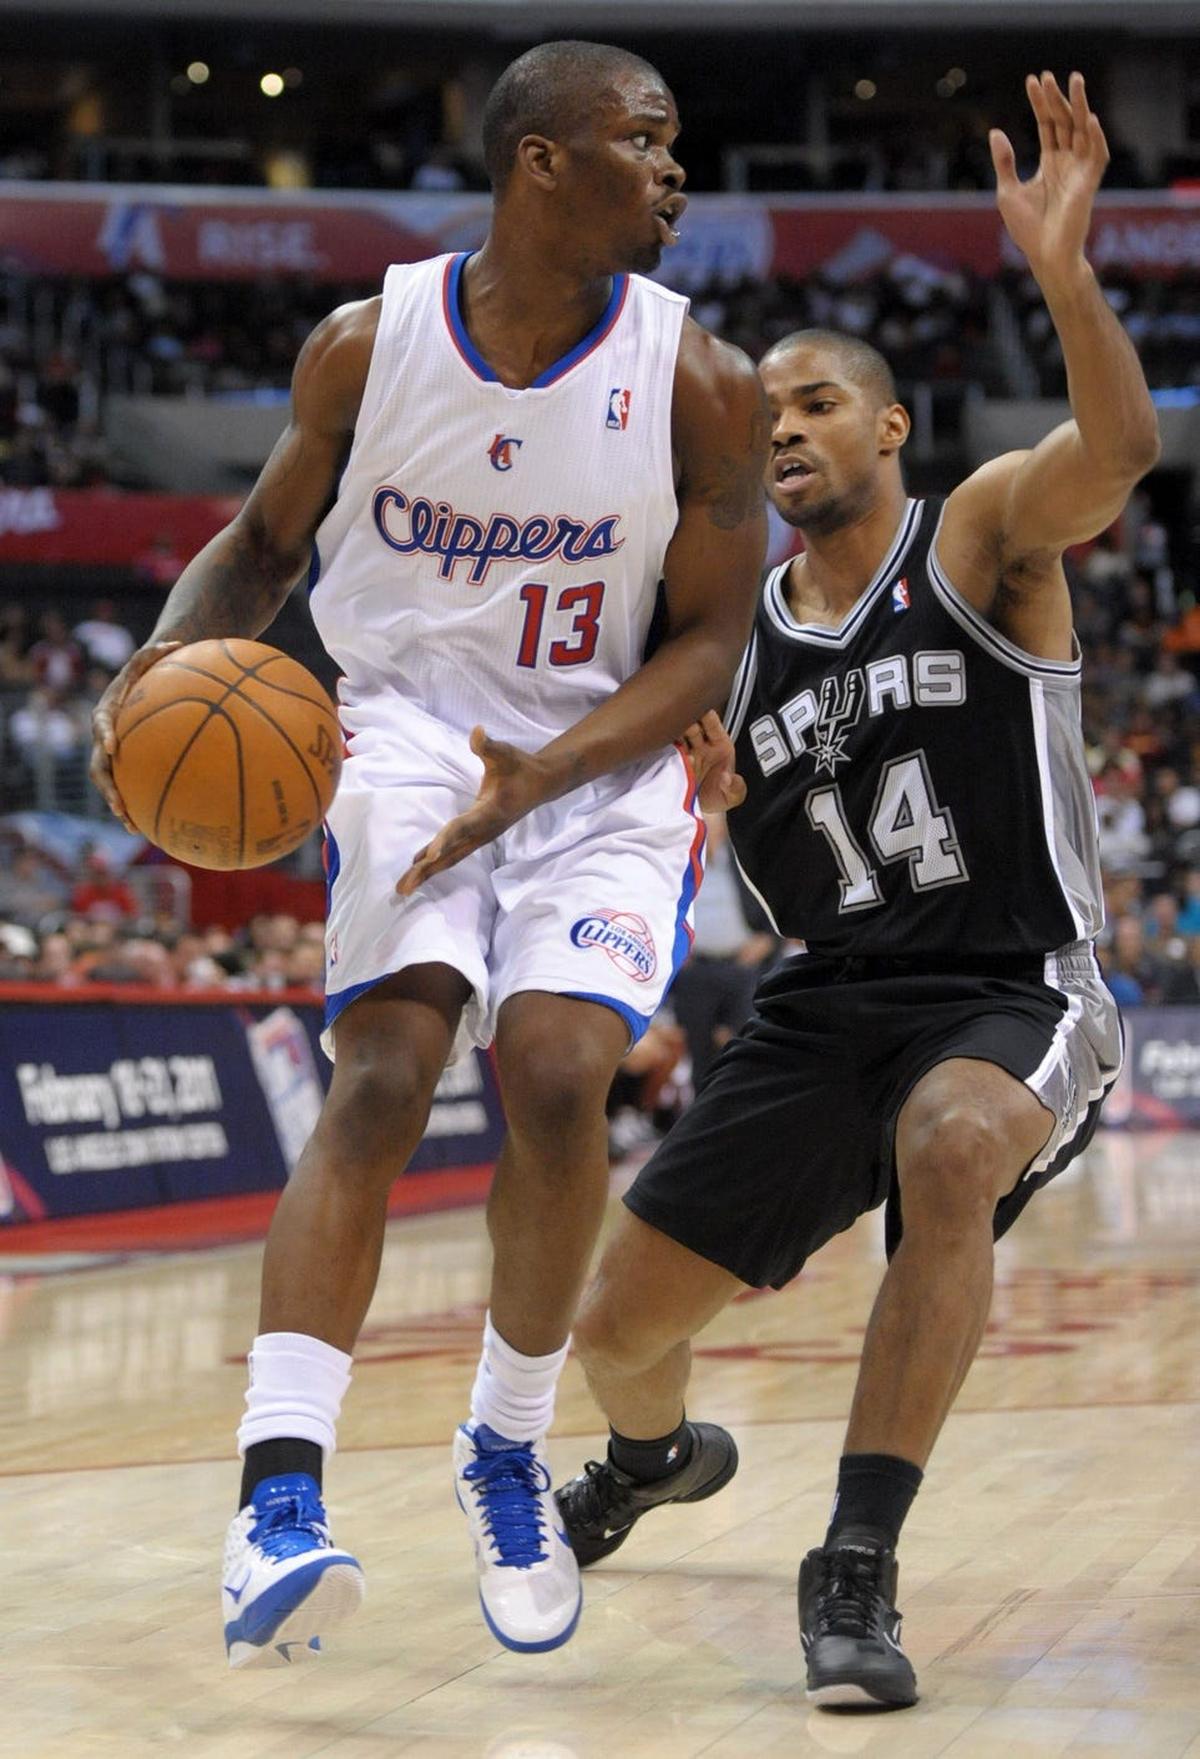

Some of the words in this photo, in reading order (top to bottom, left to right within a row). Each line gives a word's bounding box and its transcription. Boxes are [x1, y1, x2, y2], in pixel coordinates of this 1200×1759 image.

[372, 485, 626, 585] Clippers
[516, 580, 606, 669] 13
[749, 649, 967, 777] SPURS
[804, 747, 970, 914] 14
[569, 917, 650, 974] CLIPPERS
[16, 1062, 120, 1131] February
